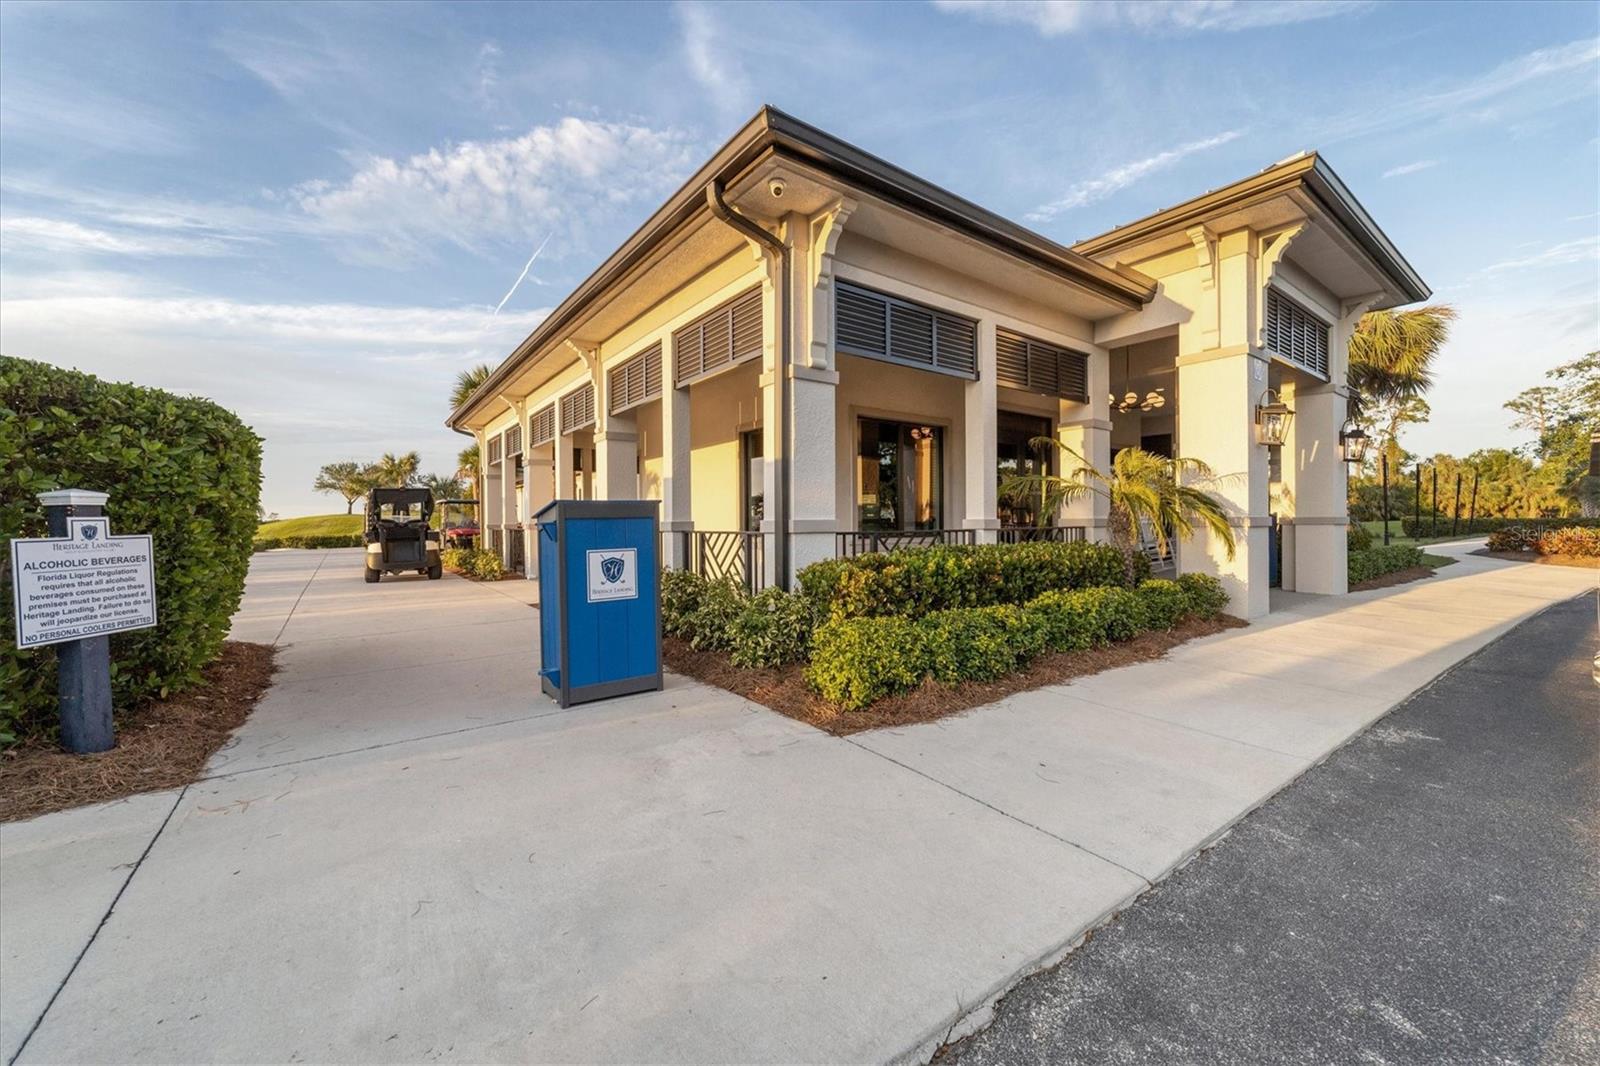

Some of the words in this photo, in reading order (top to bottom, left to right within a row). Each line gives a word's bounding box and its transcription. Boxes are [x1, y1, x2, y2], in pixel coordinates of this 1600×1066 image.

[52, 543, 89, 551] HERITAGE
[91, 541, 124, 549] LANDING
[23, 559, 89, 570] ALCOHOLIC
[91, 555, 147, 566] BEVERAGES
[37, 573, 67, 582] Florida
[69, 572, 95, 580] Liquor
[96, 568, 138, 577] Regulations
[40, 582, 76, 591] requires
[105, 576, 137, 584] alcoholic
[29, 591, 74, 601] beverages
[75, 586, 116, 596] consumed
[126, 583, 145, 591] these
[28, 600, 68, 612] premises
[69, 597, 90, 606] must
[102, 591, 140, 603] purchased
[23, 610, 61, 621] Heritage
[62, 605, 96, 616] Landing.
[98, 602, 124, 611] Failure
[40, 619, 56, 628] will
[56, 614, 99, 627] jeopardize
[113, 608, 140, 617] license.
[24, 634, 38, 642] NO
[39, 628, 81, 640] PERSONAL
[82, 622, 116, 633] COOLERS
[117, 616, 151, 627] PERMITTED
